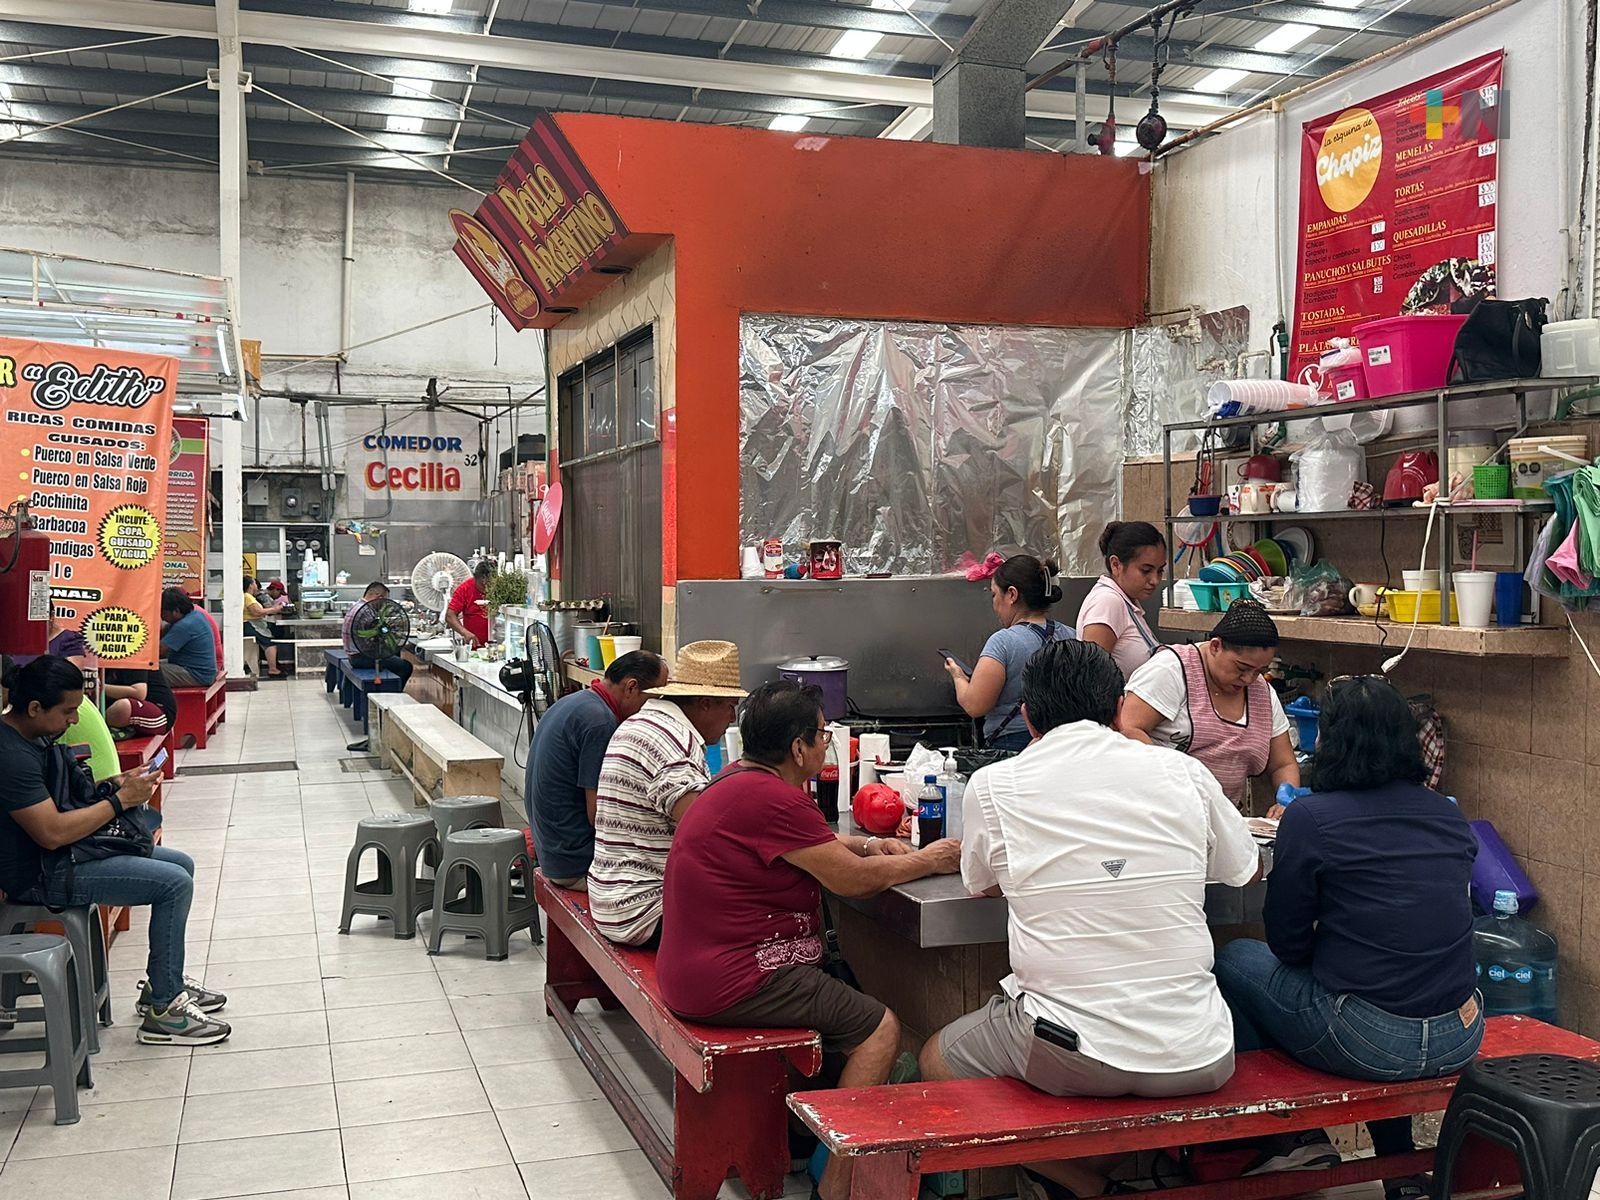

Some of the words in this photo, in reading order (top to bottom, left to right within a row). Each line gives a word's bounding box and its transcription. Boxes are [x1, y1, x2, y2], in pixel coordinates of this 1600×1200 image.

[1363, 116, 1373, 128] de
[1316, 133, 1381, 186] Chapiz
[1395, 142, 1434, 161] MEMELAS
[1394, 181, 1424, 198] TORTAS
[498, 163, 566, 240] POLLO
[1307, 214, 1347, 232] EMPANADAS
[1393, 219, 1447, 242] QUESADILLAS
[518, 191, 616, 293] ARGENTINO
[1304, 265, 1346, 282] PANUCHOS
[1346, 263, 1352, 274] Y
[1352, 254, 1392, 272] SALBUTES
[1300, 306, 1346, 321] TOSTADAS
[1298, 340, 1335, 353] PLÁTAN
[8, 411, 64, 426] RICAS
[72, 418, 156, 434] COMIDAS
[48, 434, 146, 450] GUISADOS:
[363, 435, 462, 452] COMEDOR
[34, 446, 72, 464] Puerco
[76, 452, 90, 465] en
[94, 450, 123, 468] Salsa
[128, 454, 156, 471] Verde
[33, 469, 70, 486] Puerco
[75, 474, 88, 488] en
[93, 474, 121, 491] Salsa
[126, 476, 148, 494] Roja
[365, 461, 461, 492] Cecilia
[32, 492, 88, 511] Cochinita
[116, 514, 150, 526] INCLUYE:
[50, 540, 94, 558] ondigas
[110, 537, 152, 548] GUISADO
[114, 548, 122, 558] Y
[122, 549, 147, 559] AGUA
[54, 563, 72, 579] le
[56, 607, 76, 618] llo
[104, 612, 128, 622] PARA
[92, 622, 123, 632] LLEVAR
[127, 623, 140, 634] NO
[96, 633, 134, 644] INCLUYE:
[102, 643, 127, 653] AGUA
[1488, 968, 1505, 978] ciel
[1515, 970, 1530, 979] ciel
